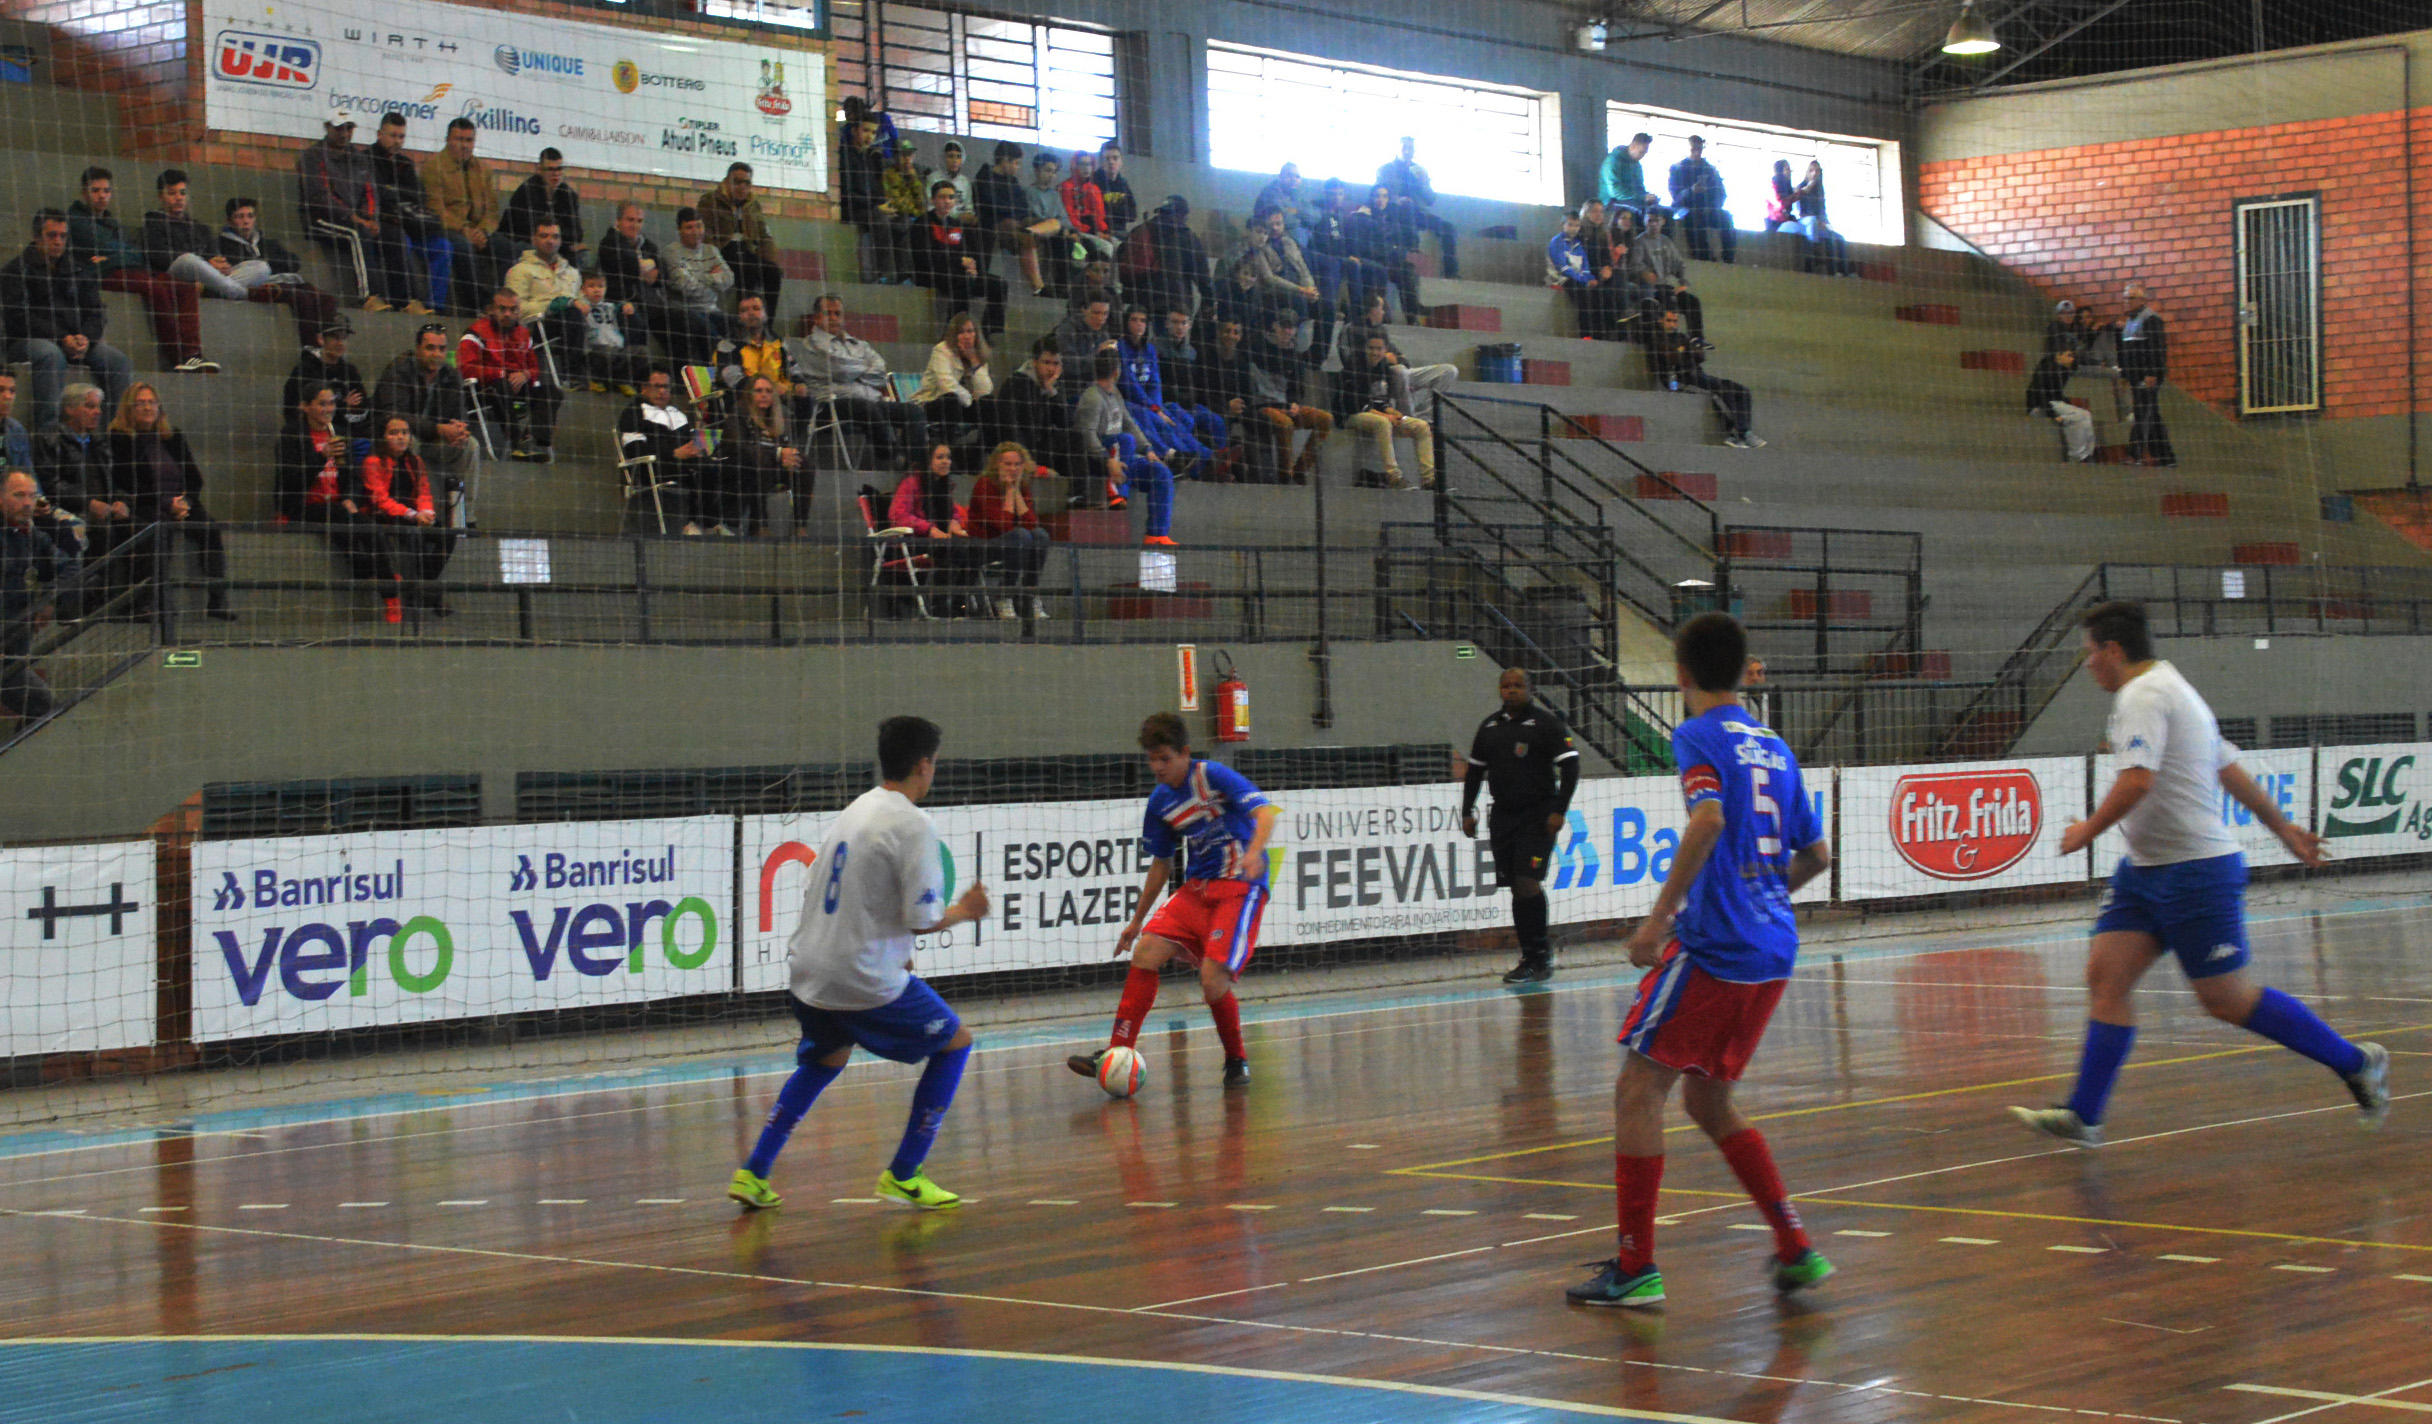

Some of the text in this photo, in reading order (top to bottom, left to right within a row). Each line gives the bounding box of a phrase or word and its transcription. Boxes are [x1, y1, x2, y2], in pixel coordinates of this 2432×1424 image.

[220, 38, 312, 83] UJR
[345, 28, 459, 53] WIRTH
[522, 51, 585, 76] UNIQUE
[329, 88, 438, 120] bancorenner
[641, 73, 705, 91] BOTTERO
[699, 131, 738, 157] Pneus
[2330, 756, 2416, 809] SLC
[1751, 766, 1783, 856] 5
[1901, 786, 2033, 845] Fritz Frida
[545, 845, 676, 890] Banrisul
[823, 840, 849, 916] 8
[1004, 837, 1153, 883] ESPORTE
[1296, 839, 1499, 911] FEEVALE
[254, 859, 404, 909] Banrisul
[1003, 884, 1145, 931] E LAZER
[1296, 906, 1499, 936] CONHECIMENTO PARA INOVAR O MUNDO
[213, 915, 455, 1006] vero
[509, 897, 718, 982] vero
